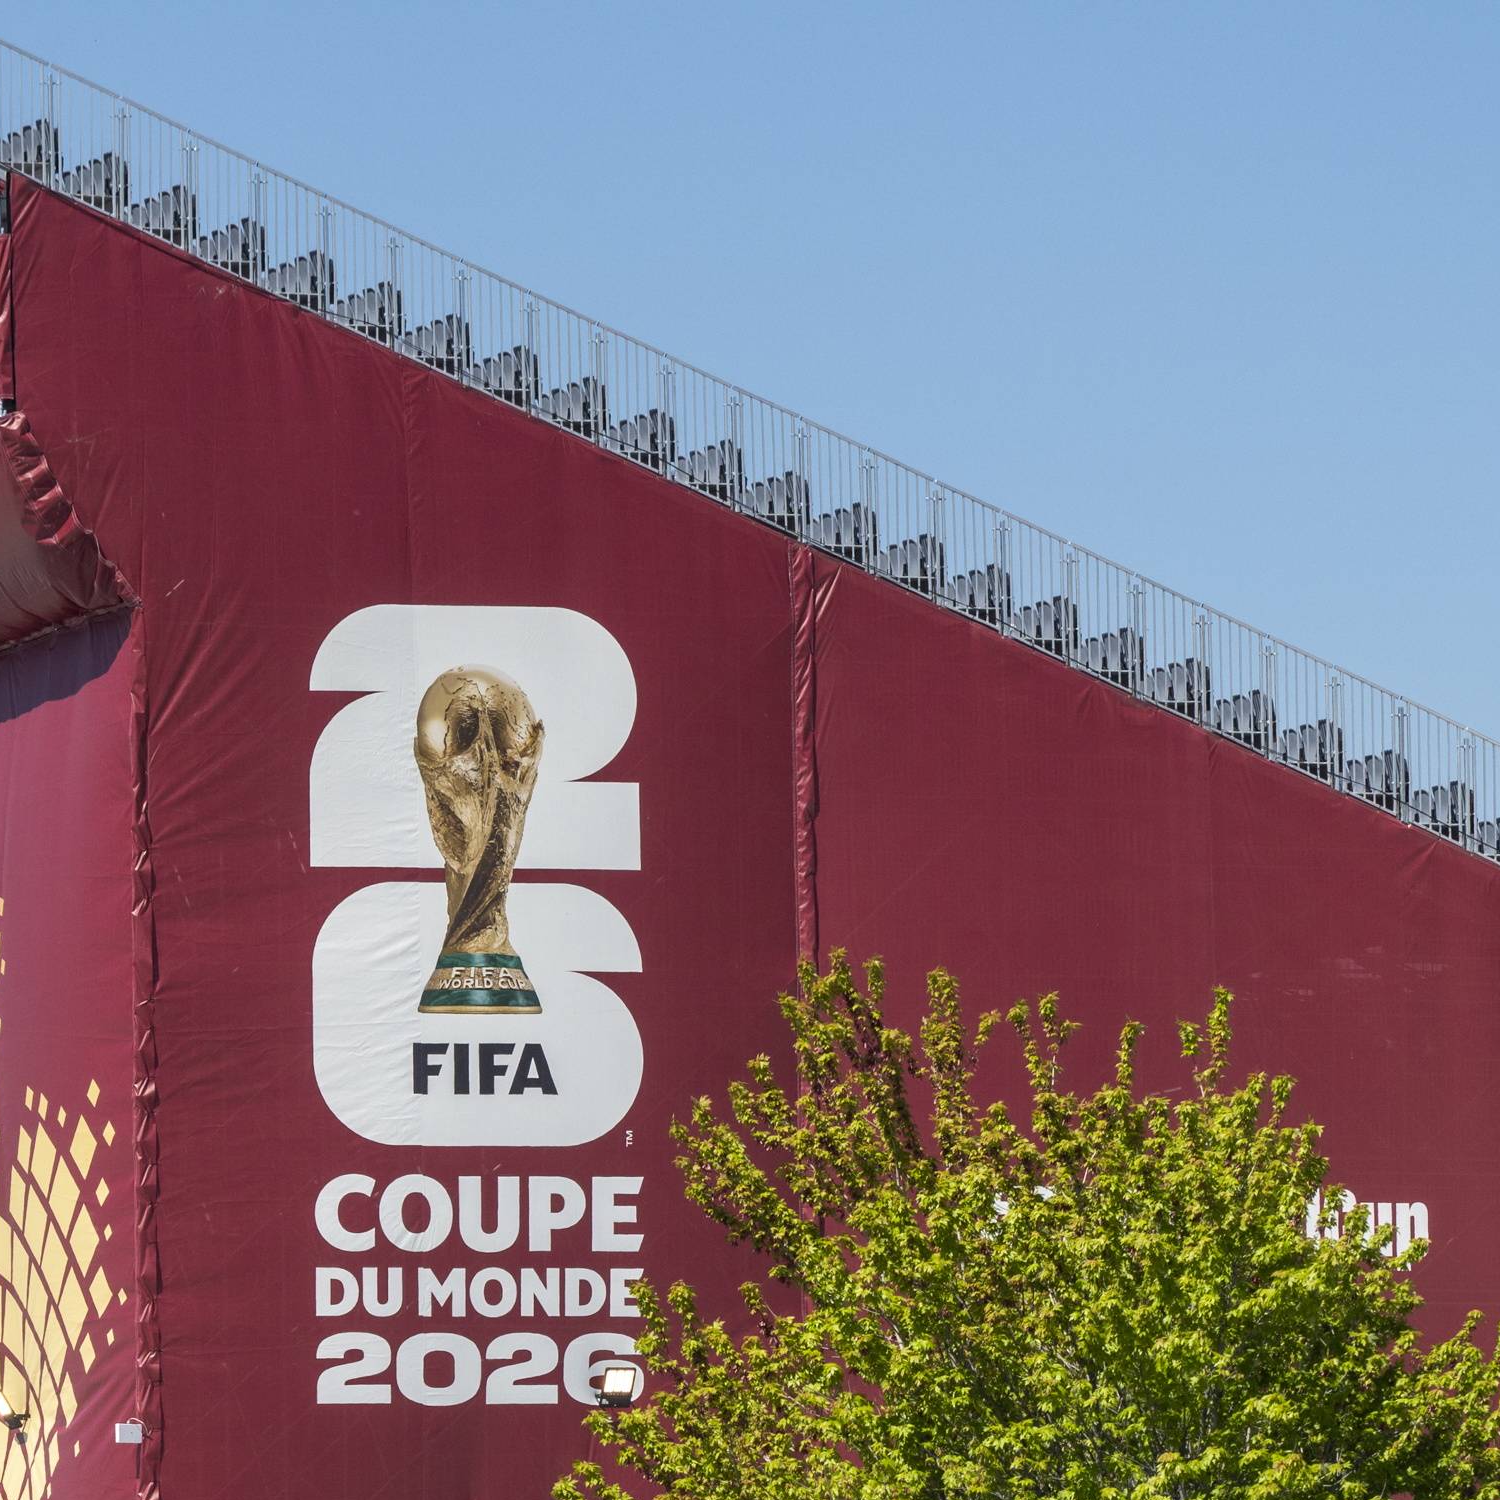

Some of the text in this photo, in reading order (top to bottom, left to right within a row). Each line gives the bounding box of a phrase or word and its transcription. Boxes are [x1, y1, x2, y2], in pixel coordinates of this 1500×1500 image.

[439, 978, 527, 990] WORLD CUP
[451, 966, 513, 978] FIFA
[412, 1042, 559, 1096] FIFA
[314, 1173, 645, 1253] COUPE
[315, 1267, 645, 1318] DU MONDE
[316, 1331, 645, 1407] 2026
